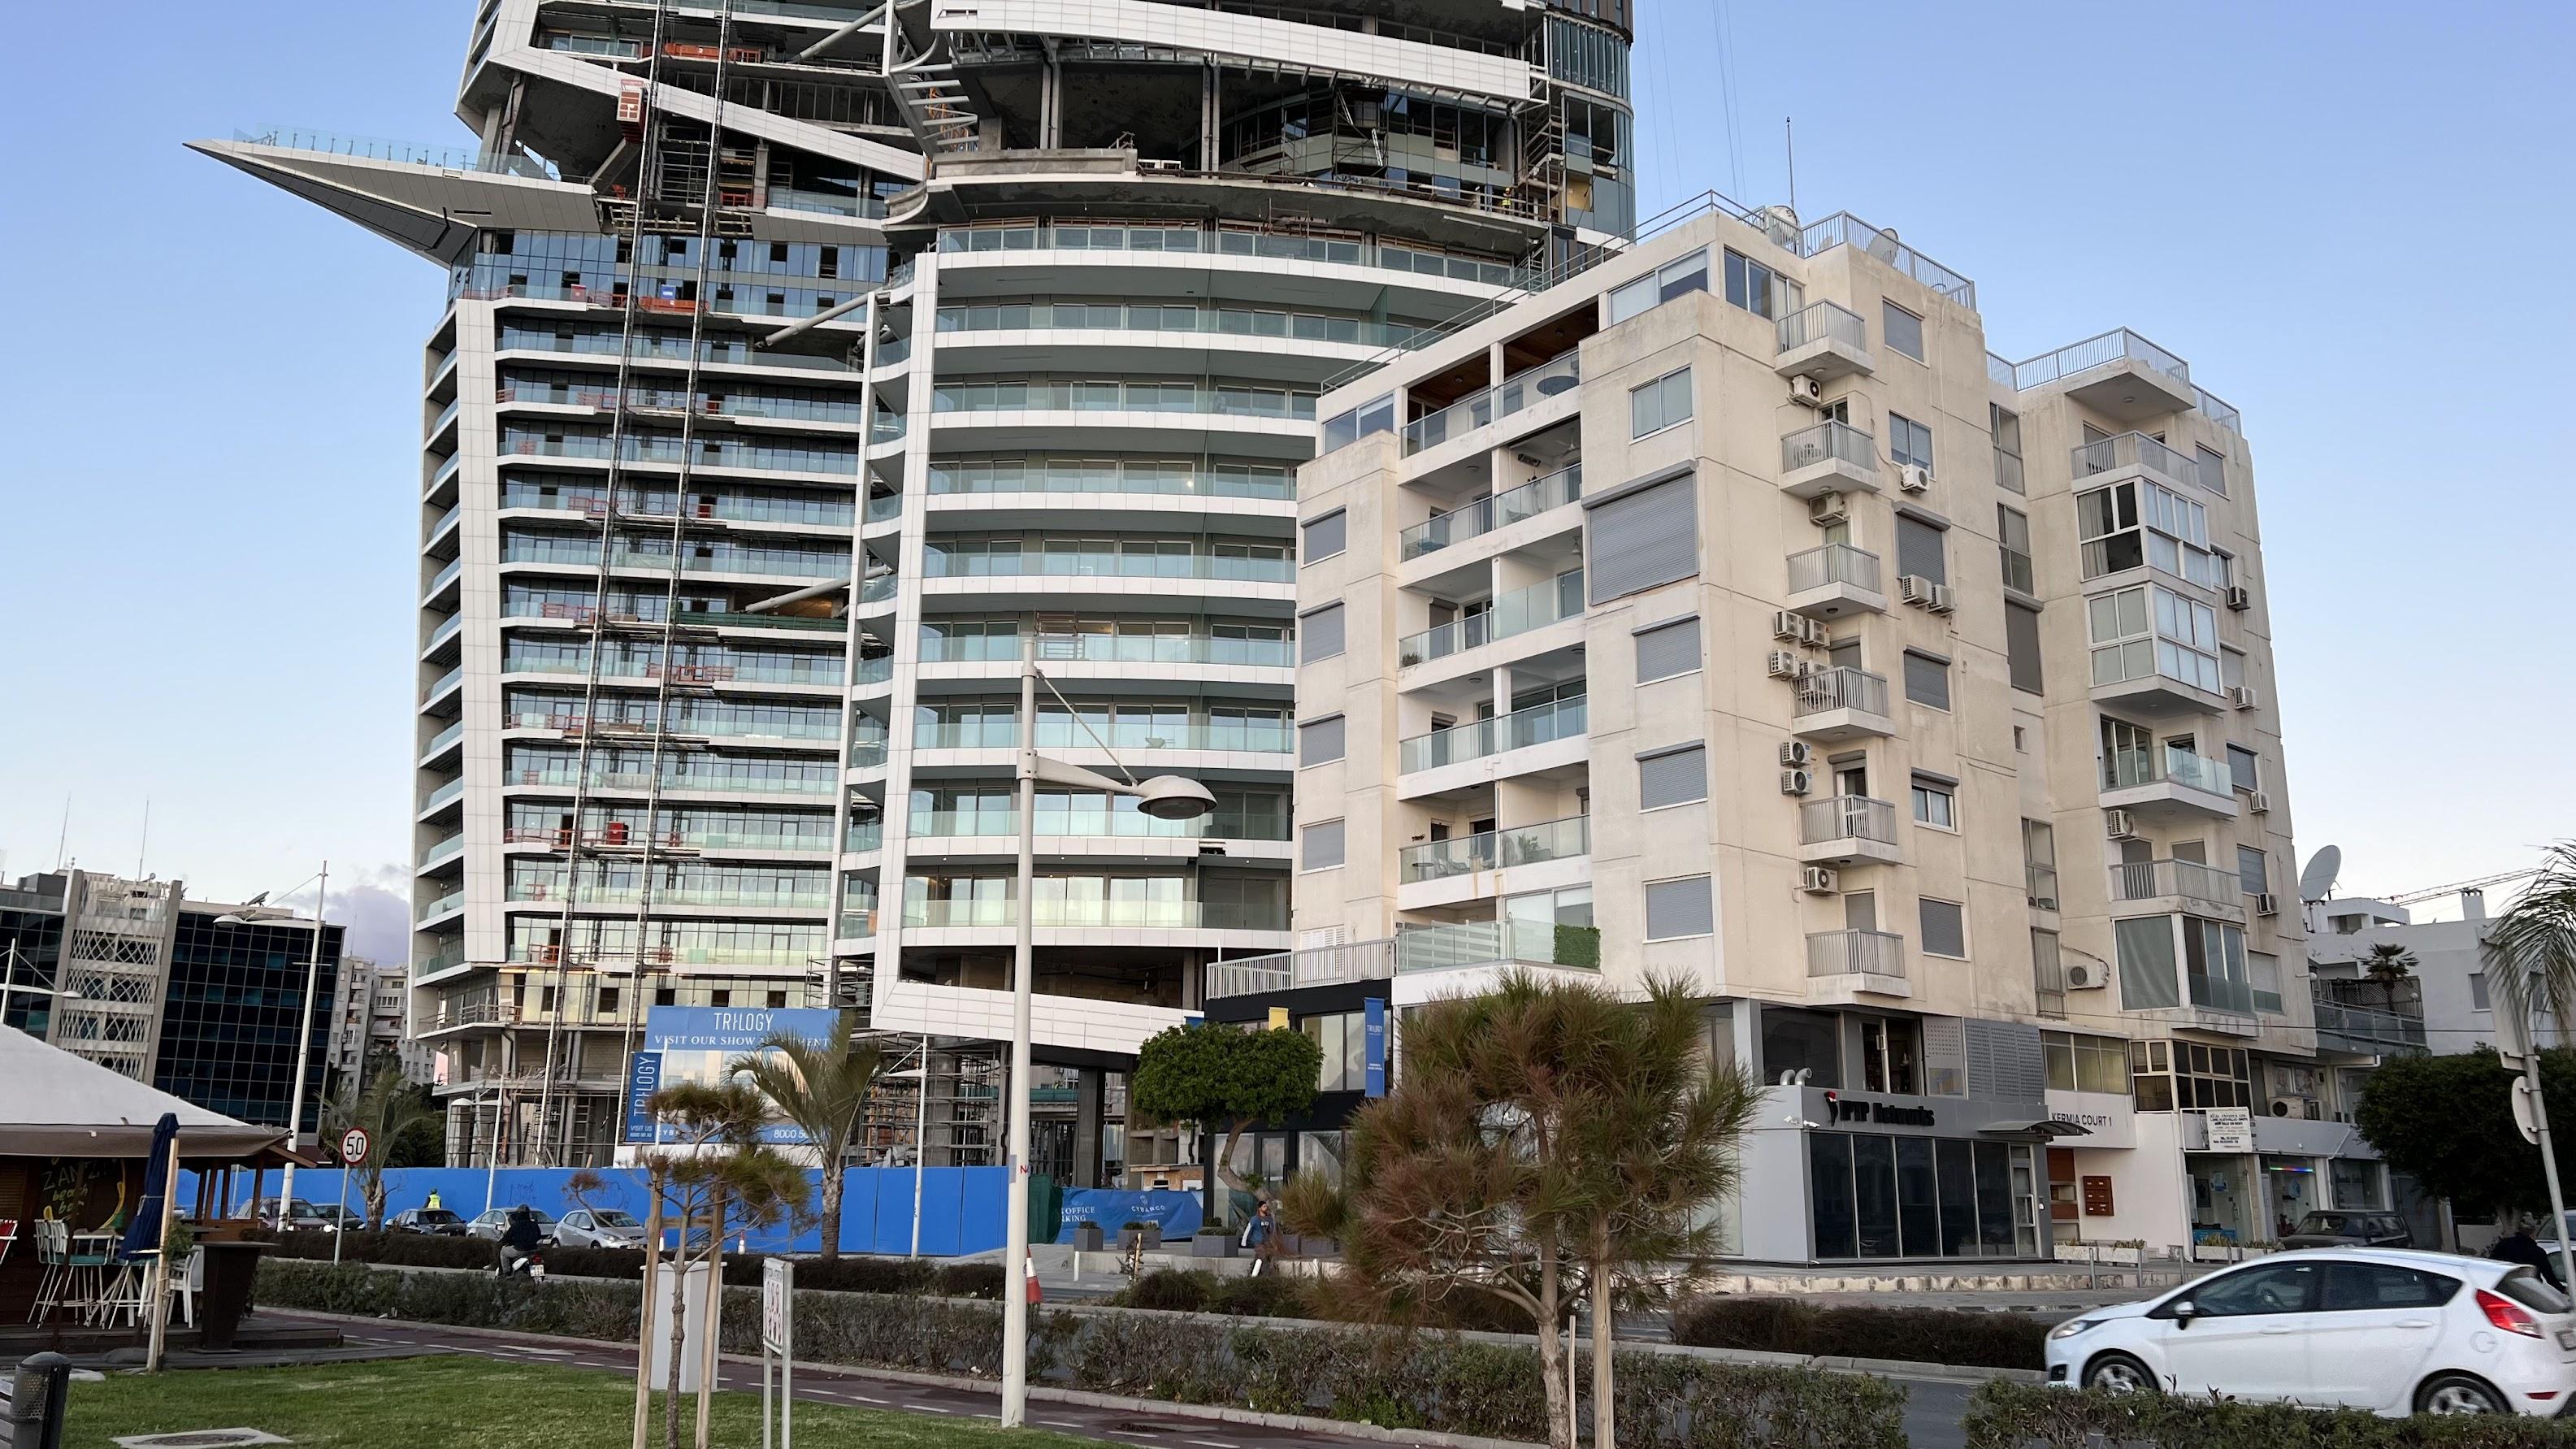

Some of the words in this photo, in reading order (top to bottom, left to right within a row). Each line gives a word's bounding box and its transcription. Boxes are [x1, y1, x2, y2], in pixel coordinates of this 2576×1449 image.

[713, 1013, 774, 1031] TRILOGY
[654, 1035, 687, 1045] VISIT
[691, 1035, 716, 1045] OUR
[721, 1036, 756, 1046] SHOW
[2051, 1113, 2080, 1125] KERMIA
[2081, 1114, 2107, 1126] COURT
[2109, 1116, 2113, 1127] 1
[774, 1129, 797, 1139] 8000
[346, 1136, 364, 1156] 50
[1065, 1206, 1095, 1215] OFFICE
[1130, 1205, 1165, 1213] CYBARCO
